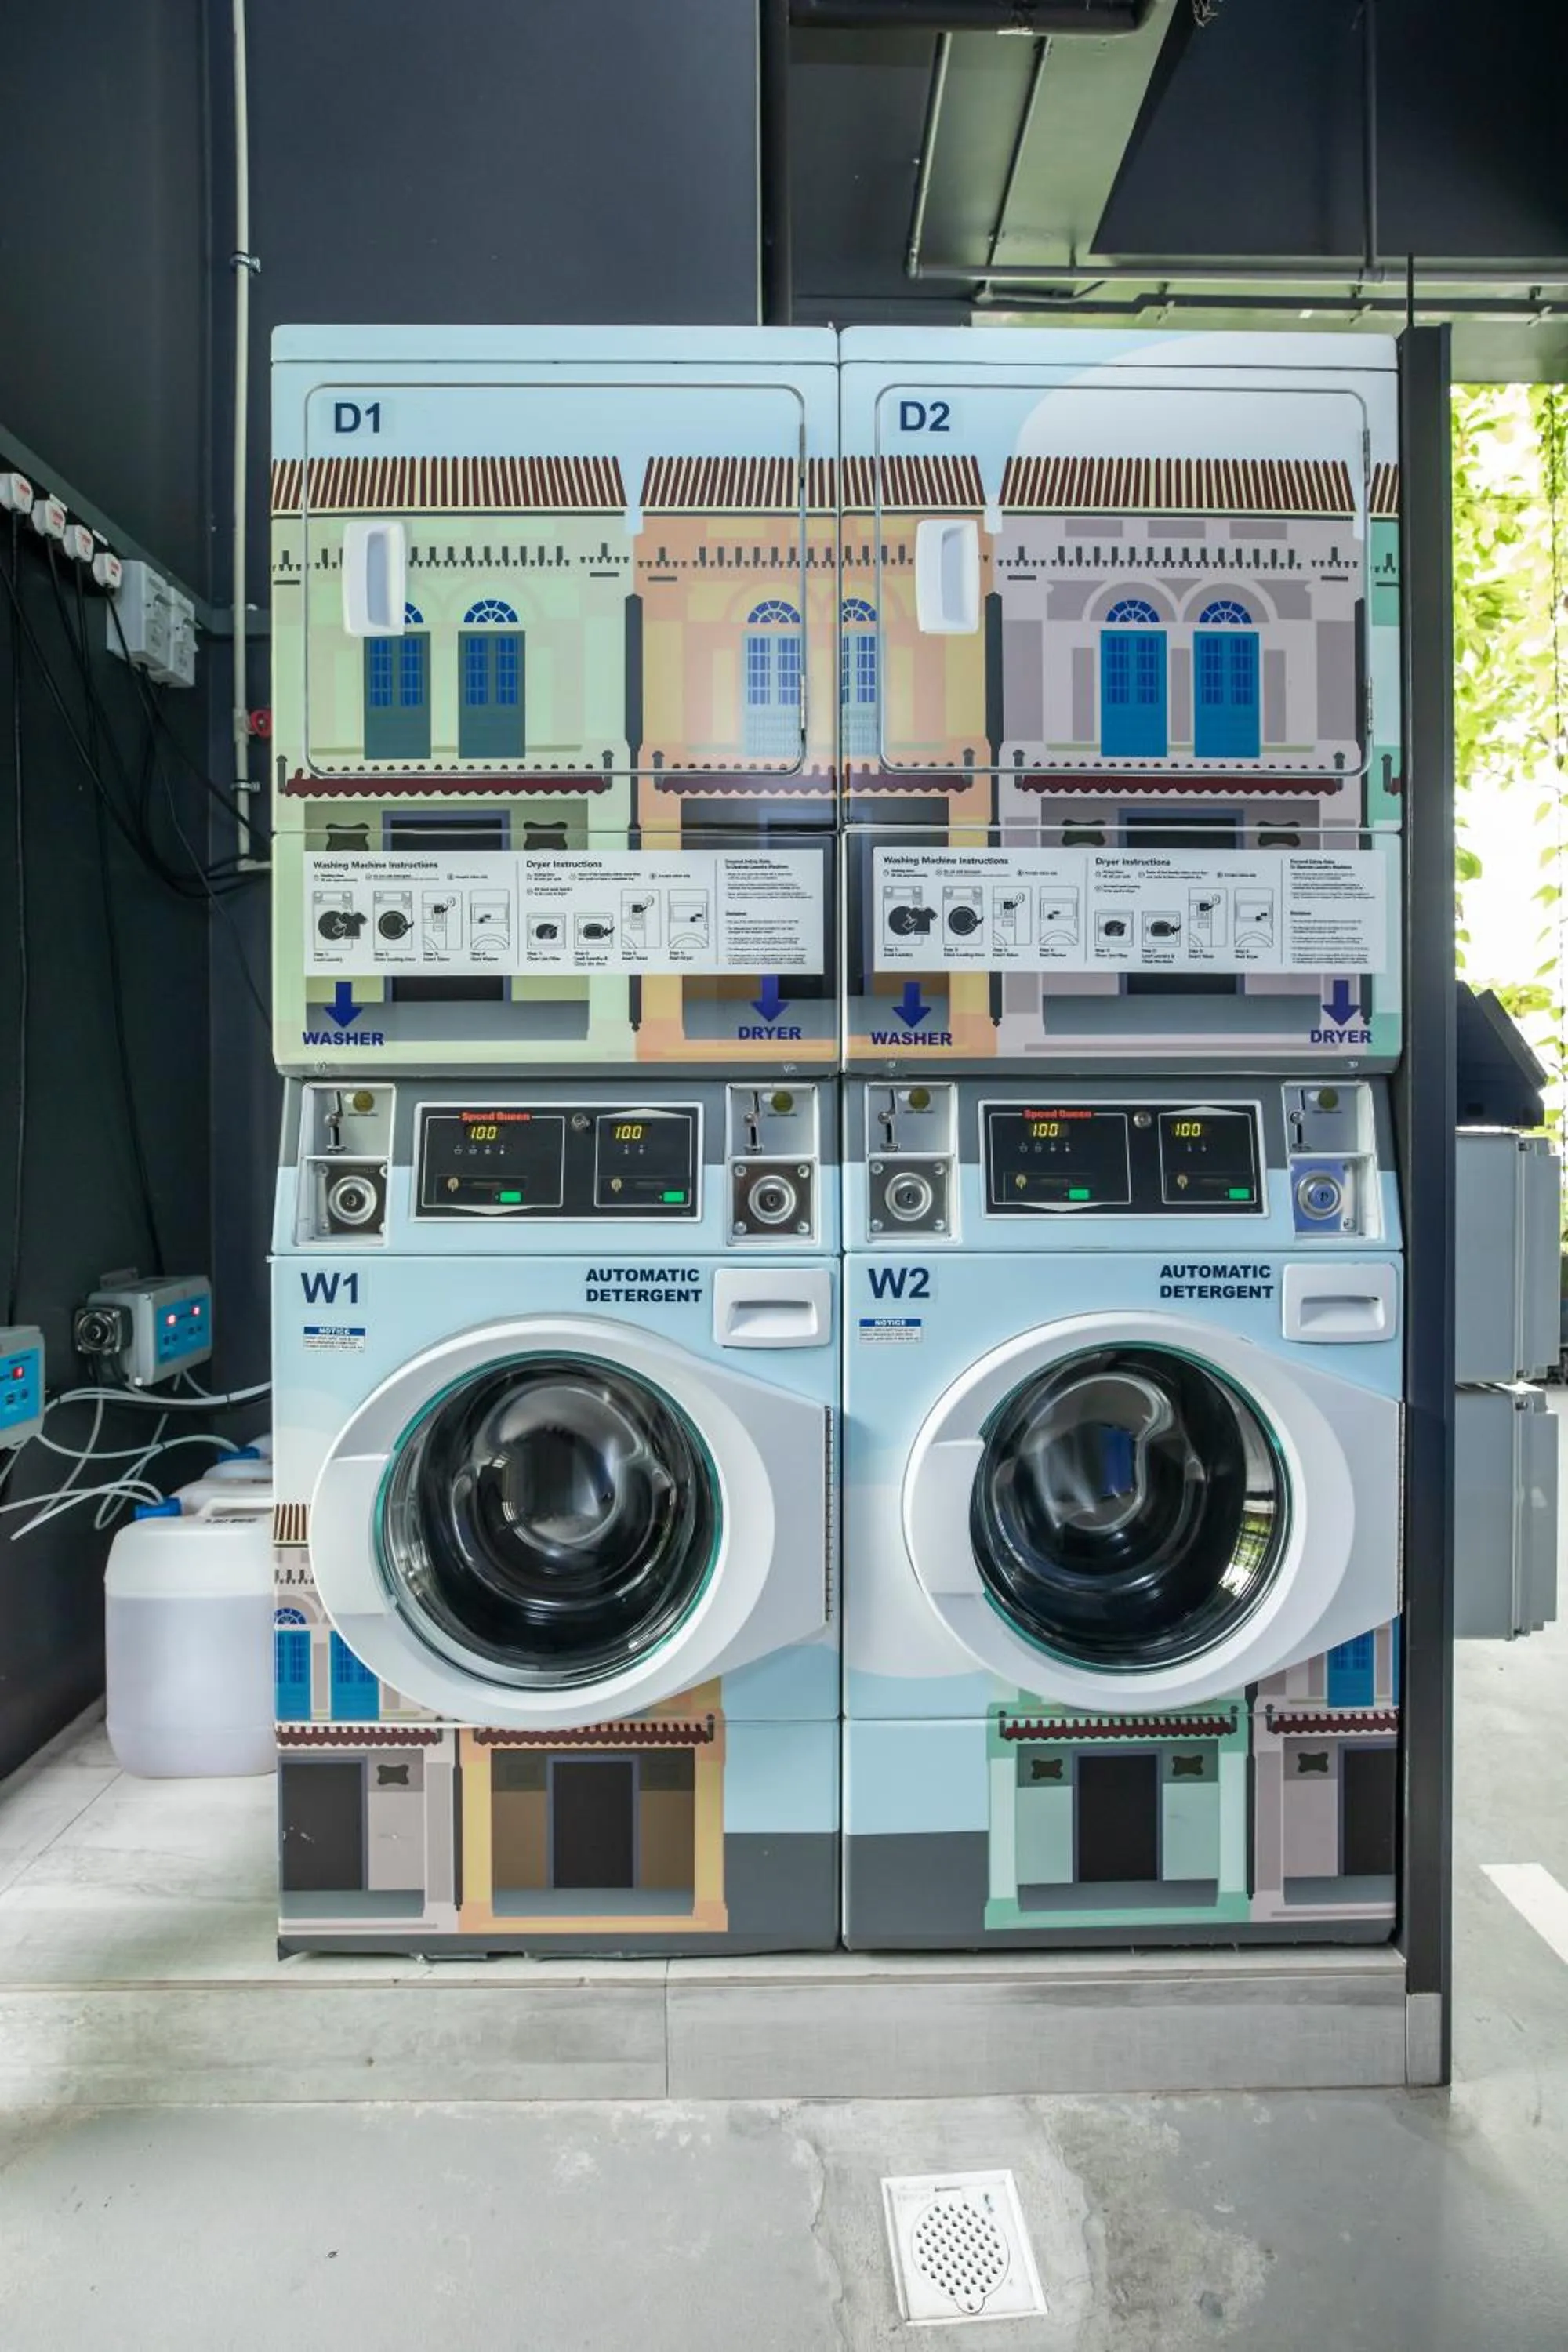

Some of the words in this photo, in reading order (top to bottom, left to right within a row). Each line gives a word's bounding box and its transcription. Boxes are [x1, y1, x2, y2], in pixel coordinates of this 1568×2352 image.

[335, 402, 380, 433] D1
[900, 401, 950, 432] D2
[314, 861, 349, 870] Washing
[389, 860, 438, 869] Instructions
[526, 860, 550, 869] Dryer
[884, 856, 919, 866] Washing
[921, 856, 956, 865] Machine
[959, 856, 1008, 865] Instructions
[1095, 857, 1120, 866] Dryer
[1122, 857, 1171, 866] Instructions
[302, 1031, 384, 1045] WASHER
[738, 1025, 802, 1040] DRYER
[871, 1031, 953, 1046] WASHER
[1310, 1029, 1372, 1044] DRYER
[463, 1112, 495, 1122] Speed
[496, 1111, 530, 1120] Queen
[1024, 1109, 1057, 1120] Speed
[1058, 1109, 1091, 1119] Queen
[471, 1125, 497, 1139] 100
[615, 1125, 642, 1139] 100
[1033, 1123, 1058, 1137] 100
[1175, 1123, 1201, 1137] 100
[586, 1268, 699, 1282] AUTOMATIC
[1160, 1265, 1271, 1279] AUTOMATIC
[300, 1272, 358, 1303] W1
[868, 1267, 930, 1298] W2
[586, 1288, 702, 1302] DETERGENT
[1160, 1285, 1274, 1298] DETERGENT
